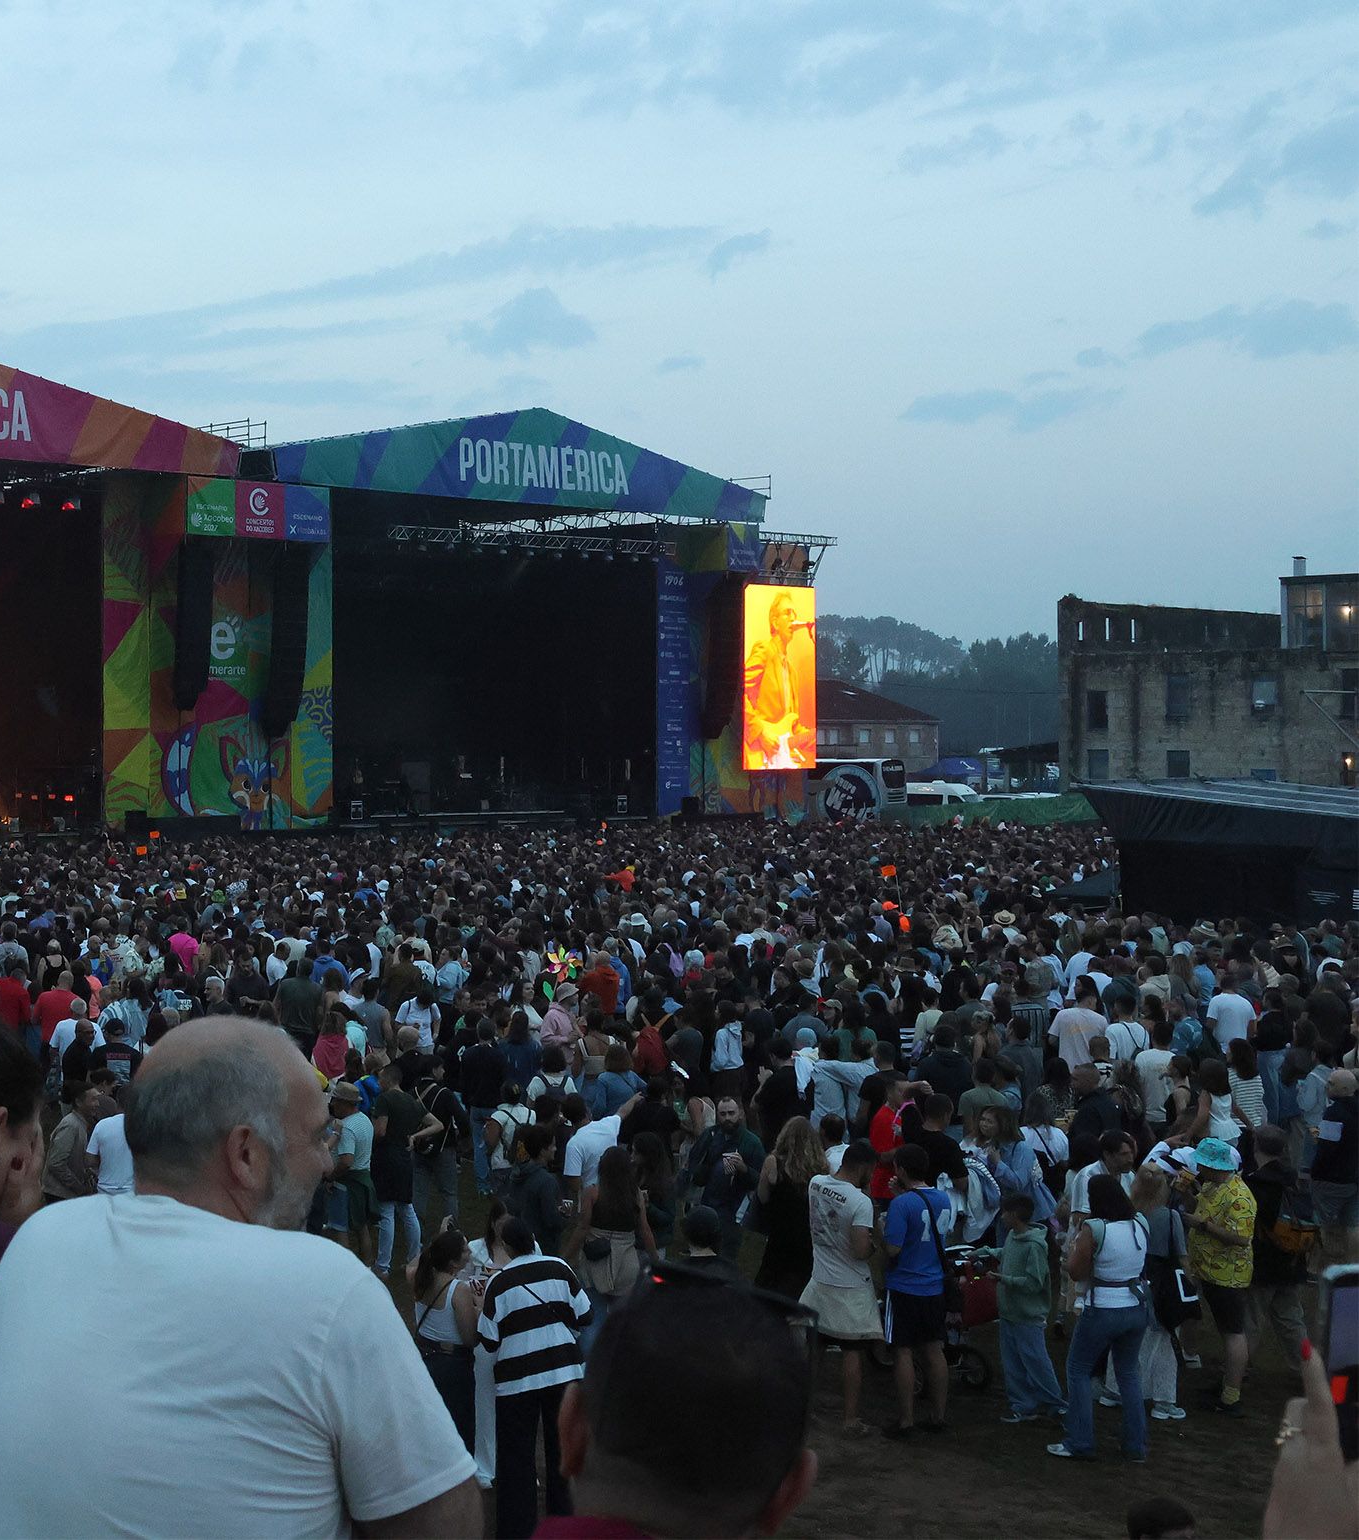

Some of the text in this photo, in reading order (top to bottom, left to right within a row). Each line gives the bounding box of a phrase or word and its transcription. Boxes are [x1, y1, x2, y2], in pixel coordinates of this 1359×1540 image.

[459, 437, 629, 495] PORTAMÉRICA
[208, 666, 246, 675] merarte
[822, 1186, 847, 1204] DUTCH
